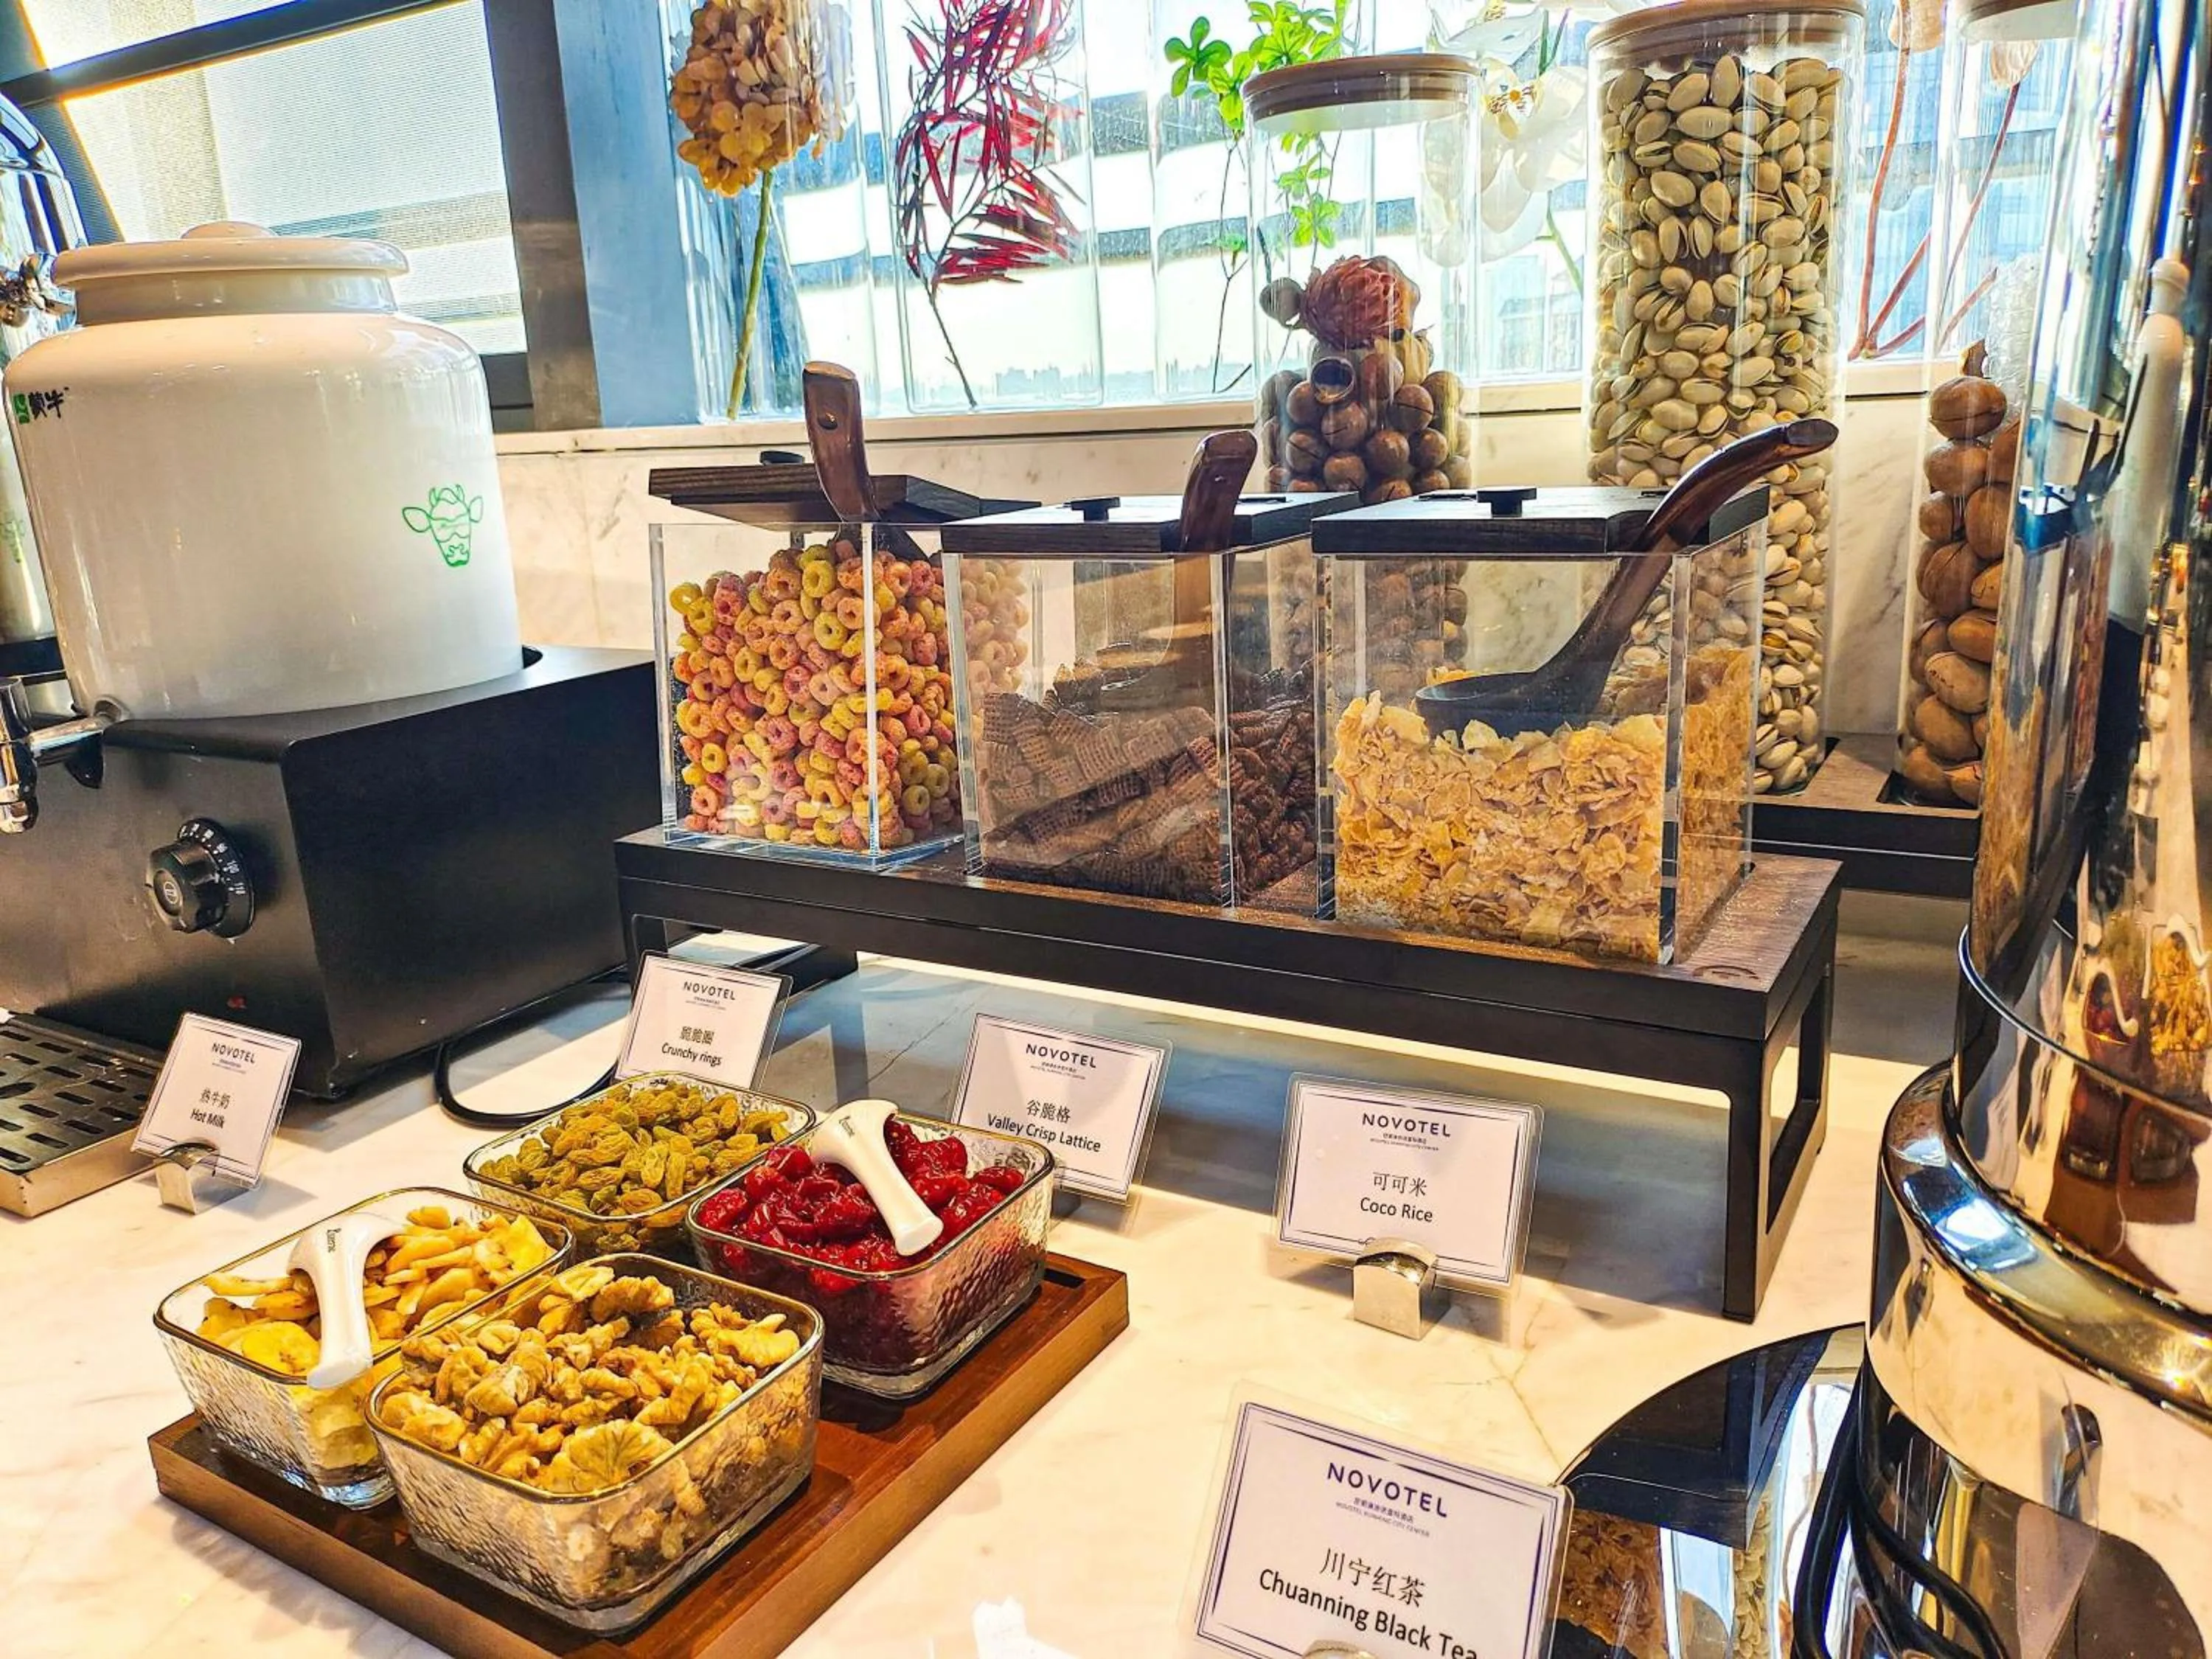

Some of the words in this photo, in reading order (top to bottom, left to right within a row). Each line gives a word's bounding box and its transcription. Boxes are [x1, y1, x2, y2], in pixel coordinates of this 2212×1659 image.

[684, 981, 736, 1001] NOVOTEL
[212, 1042, 255, 1063] NOVOTEL
[661, 1042, 698, 1062] Crunchy
[700, 1051, 723, 1067] rings
[1026, 1043, 1097, 1068] NOVOTEL
[189, 1108, 206, 1124] Hot
[206, 1113, 225, 1129] Milk
[1026, 1099, 1071, 1124] 谷脆格
[987, 1113, 1023, 1136] Valley
[1026, 1123, 1057, 1144] Crisp
[1060, 1131, 1101, 1152] Lattice
[1362, 1112, 1451, 1138] NOVOTEL
[1372, 1172, 1427, 1197] 可可米
[1360, 1197, 1397, 1217] Coco
[1402, 1203, 1433, 1222] Rice
[1327, 1461, 1448, 1517] NOVOTEL
[1319, 1548, 1425, 1608] 川宁红茶
[1258, 1568, 1369, 1632] Chuanning
[1375, 1610, 1431, 1652] Black
